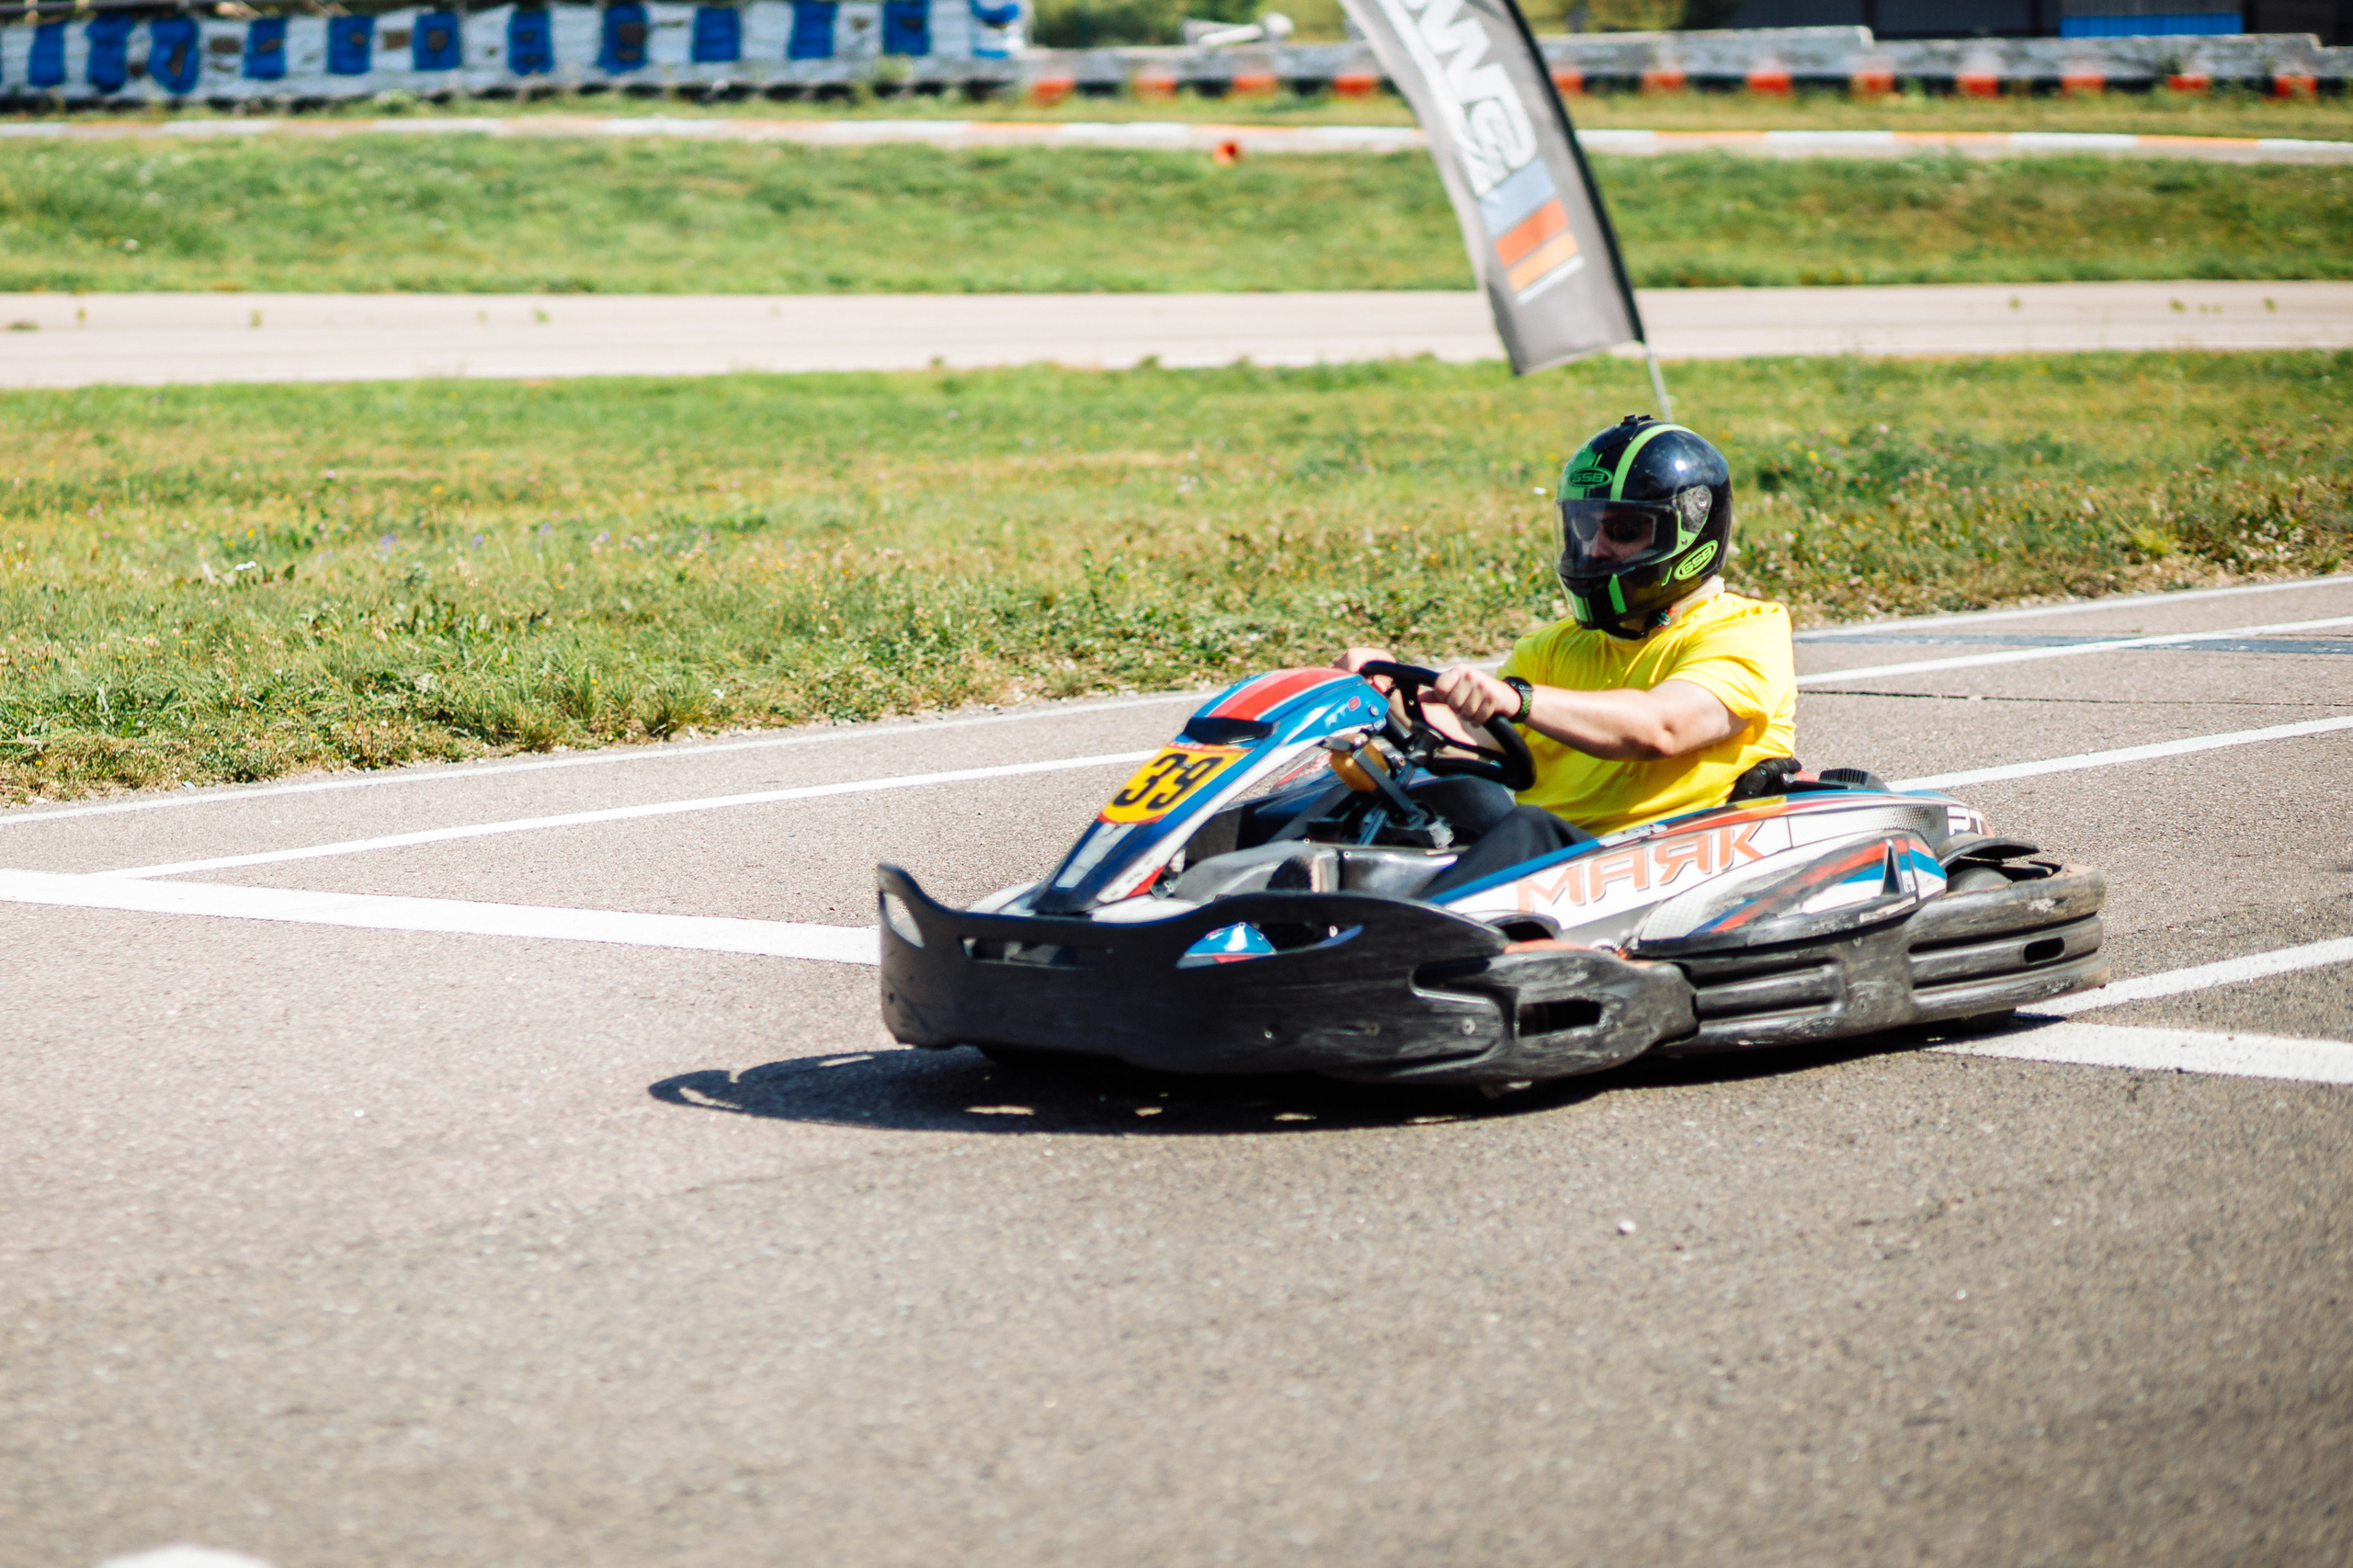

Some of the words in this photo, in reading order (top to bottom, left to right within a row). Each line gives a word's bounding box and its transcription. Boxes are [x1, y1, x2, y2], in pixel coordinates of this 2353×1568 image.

[1571, 472, 1607, 483] GSB
[1680, 544, 1713, 576] GSB
[1112, 752, 1224, 811] 39
[1517, 820, 1766, 913] МАЯК
